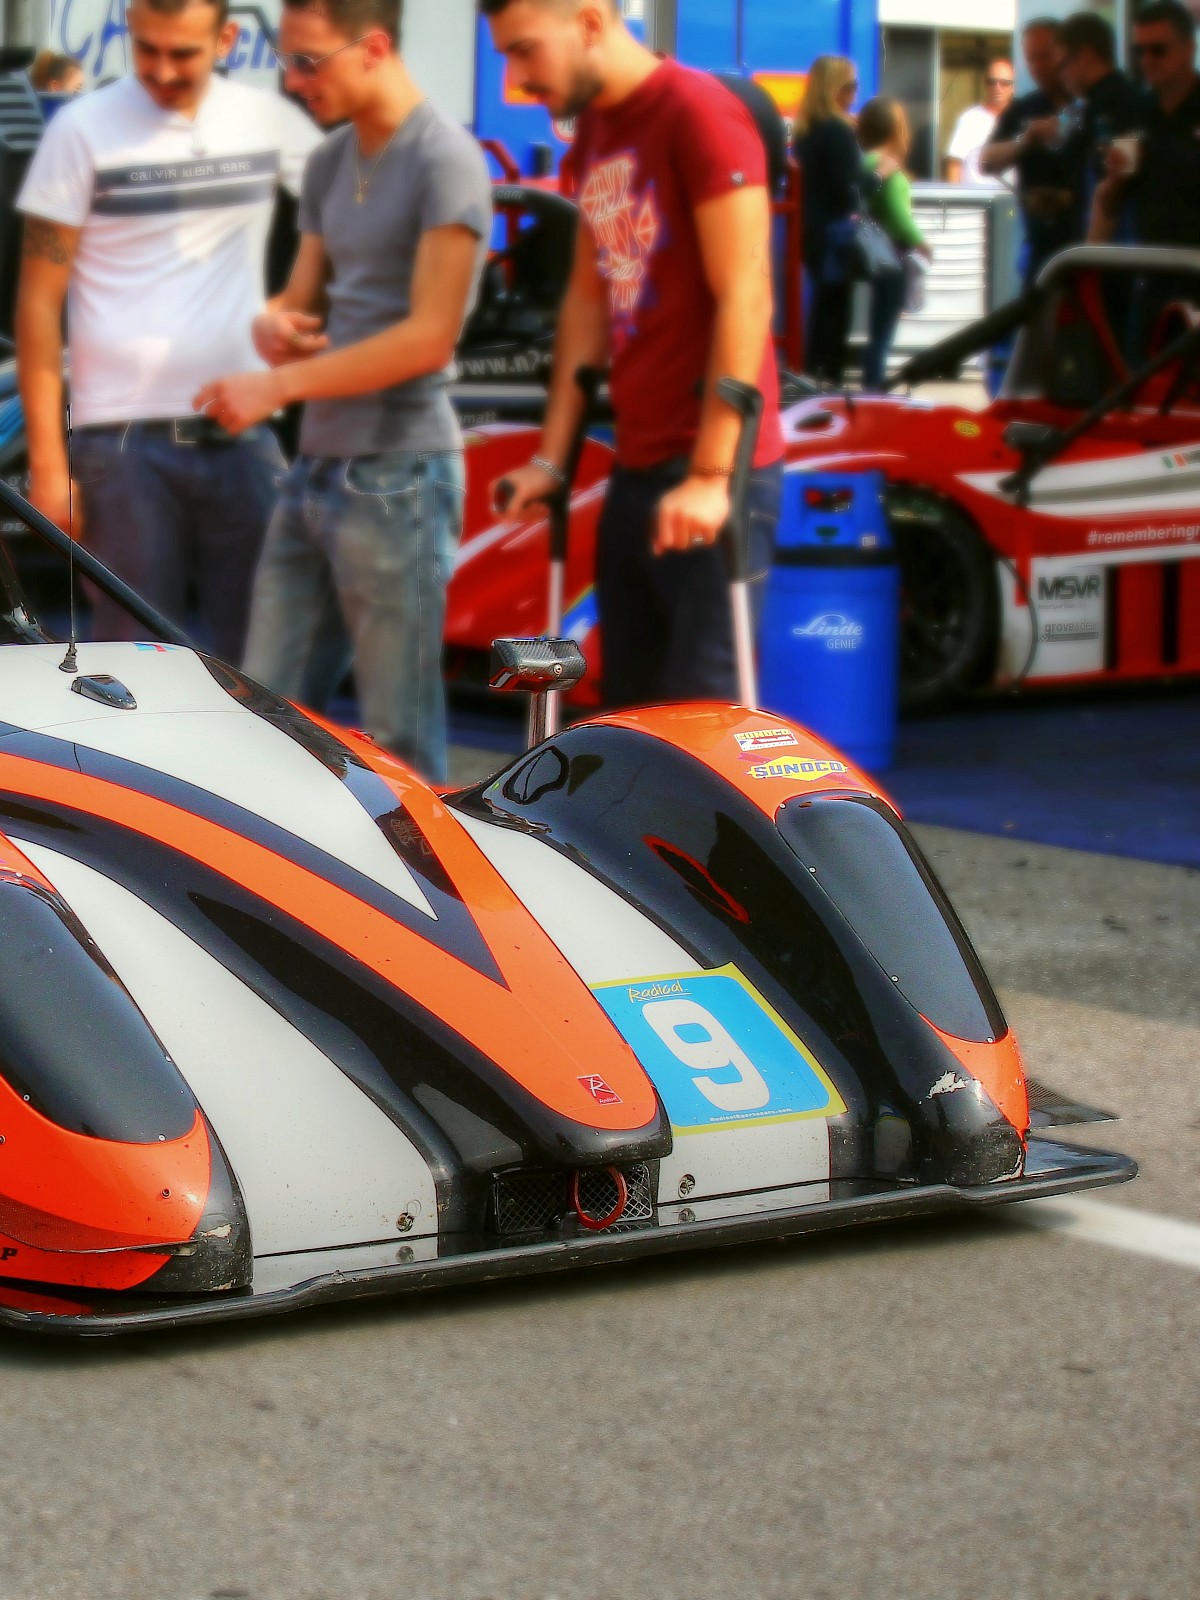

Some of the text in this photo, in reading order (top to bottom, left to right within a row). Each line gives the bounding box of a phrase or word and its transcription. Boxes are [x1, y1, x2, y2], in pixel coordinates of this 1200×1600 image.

[1038, 575, 1100, 600] MSVR
[793, 613, 863, 636] Linde
[827, 638, 857, 649] GENIE
[754, 762, 843, 777] SUNOCO
[627, 981, 684, 1003] Radical
[642, 999, 771, 1112] 9
